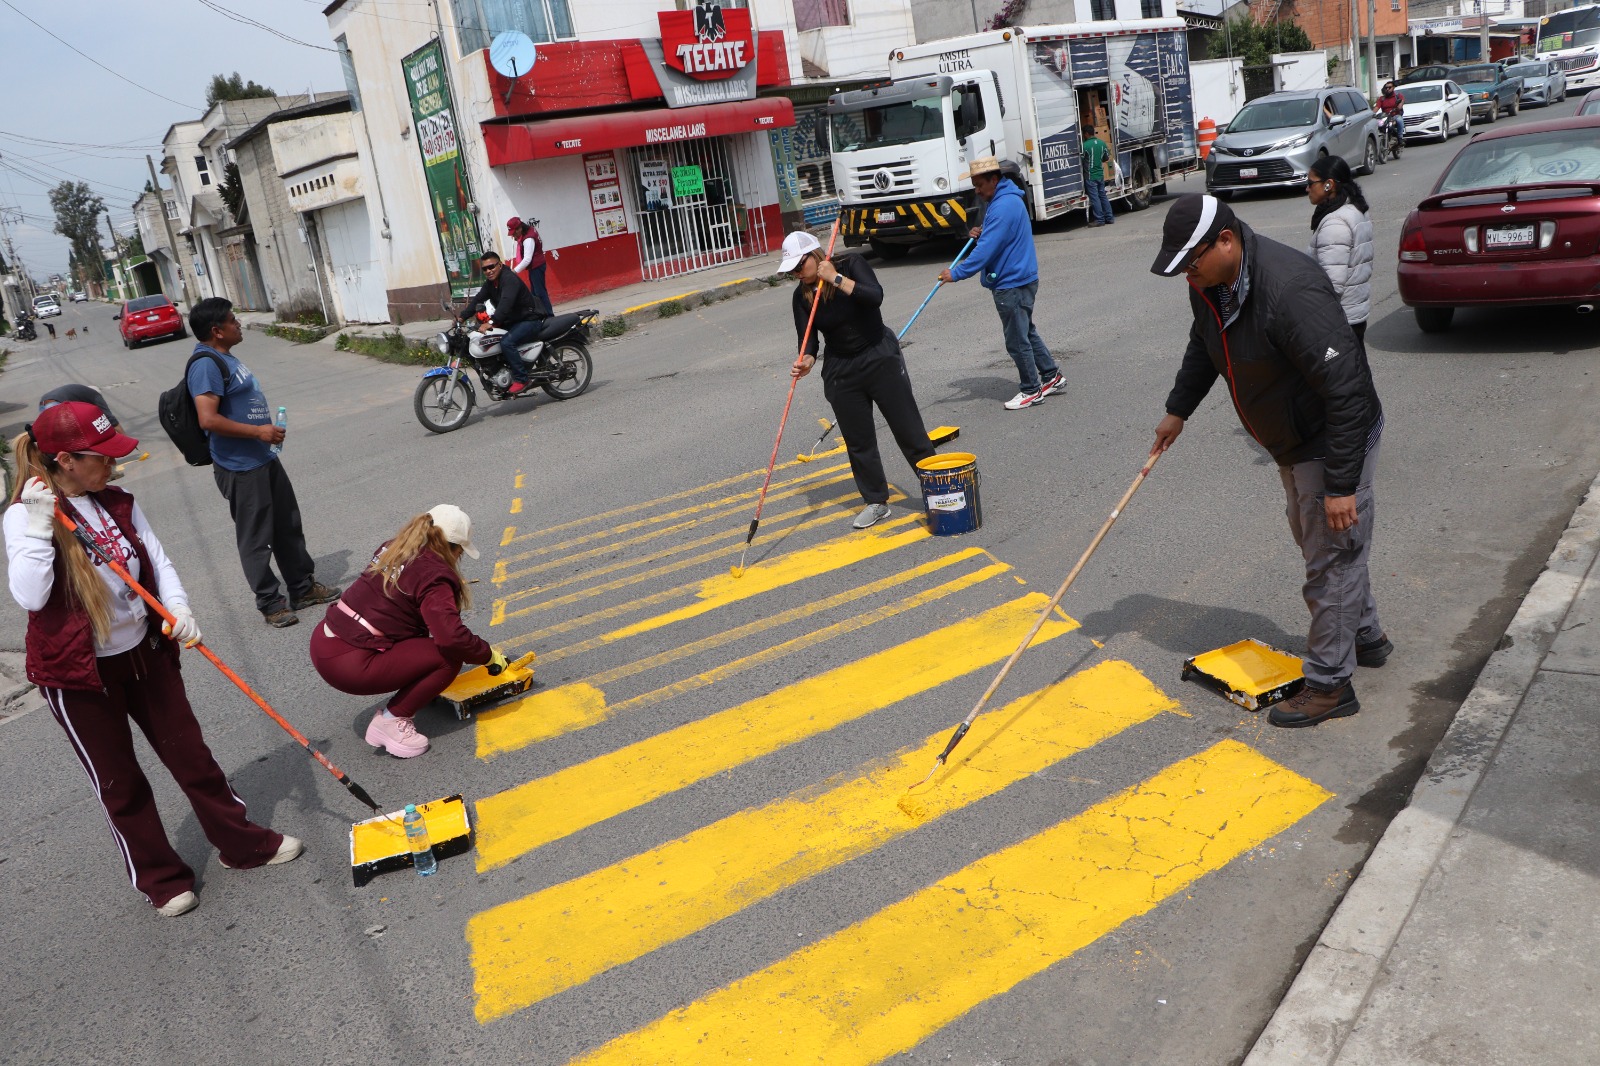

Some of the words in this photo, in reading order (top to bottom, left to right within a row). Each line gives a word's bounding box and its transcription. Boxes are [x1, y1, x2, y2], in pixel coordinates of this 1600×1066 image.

[676, 41, 746, 73] TECATE
[939, 49, 970, 61] AMSTEL
[939, 60, 972, 73] ULTRA
[725, 80, 748, 98] LARIS
[1120, 74, 1130, 127] ULTRA
[688, 123, 706, 138] LARIS
[562, 139, 581, 148] TECATE
[1045, 144, 1070, 159] AMSTEL
[1046, 158, 1070, 172] ULTRA
[1487, 231, 1533, 243] MVL-996-B
